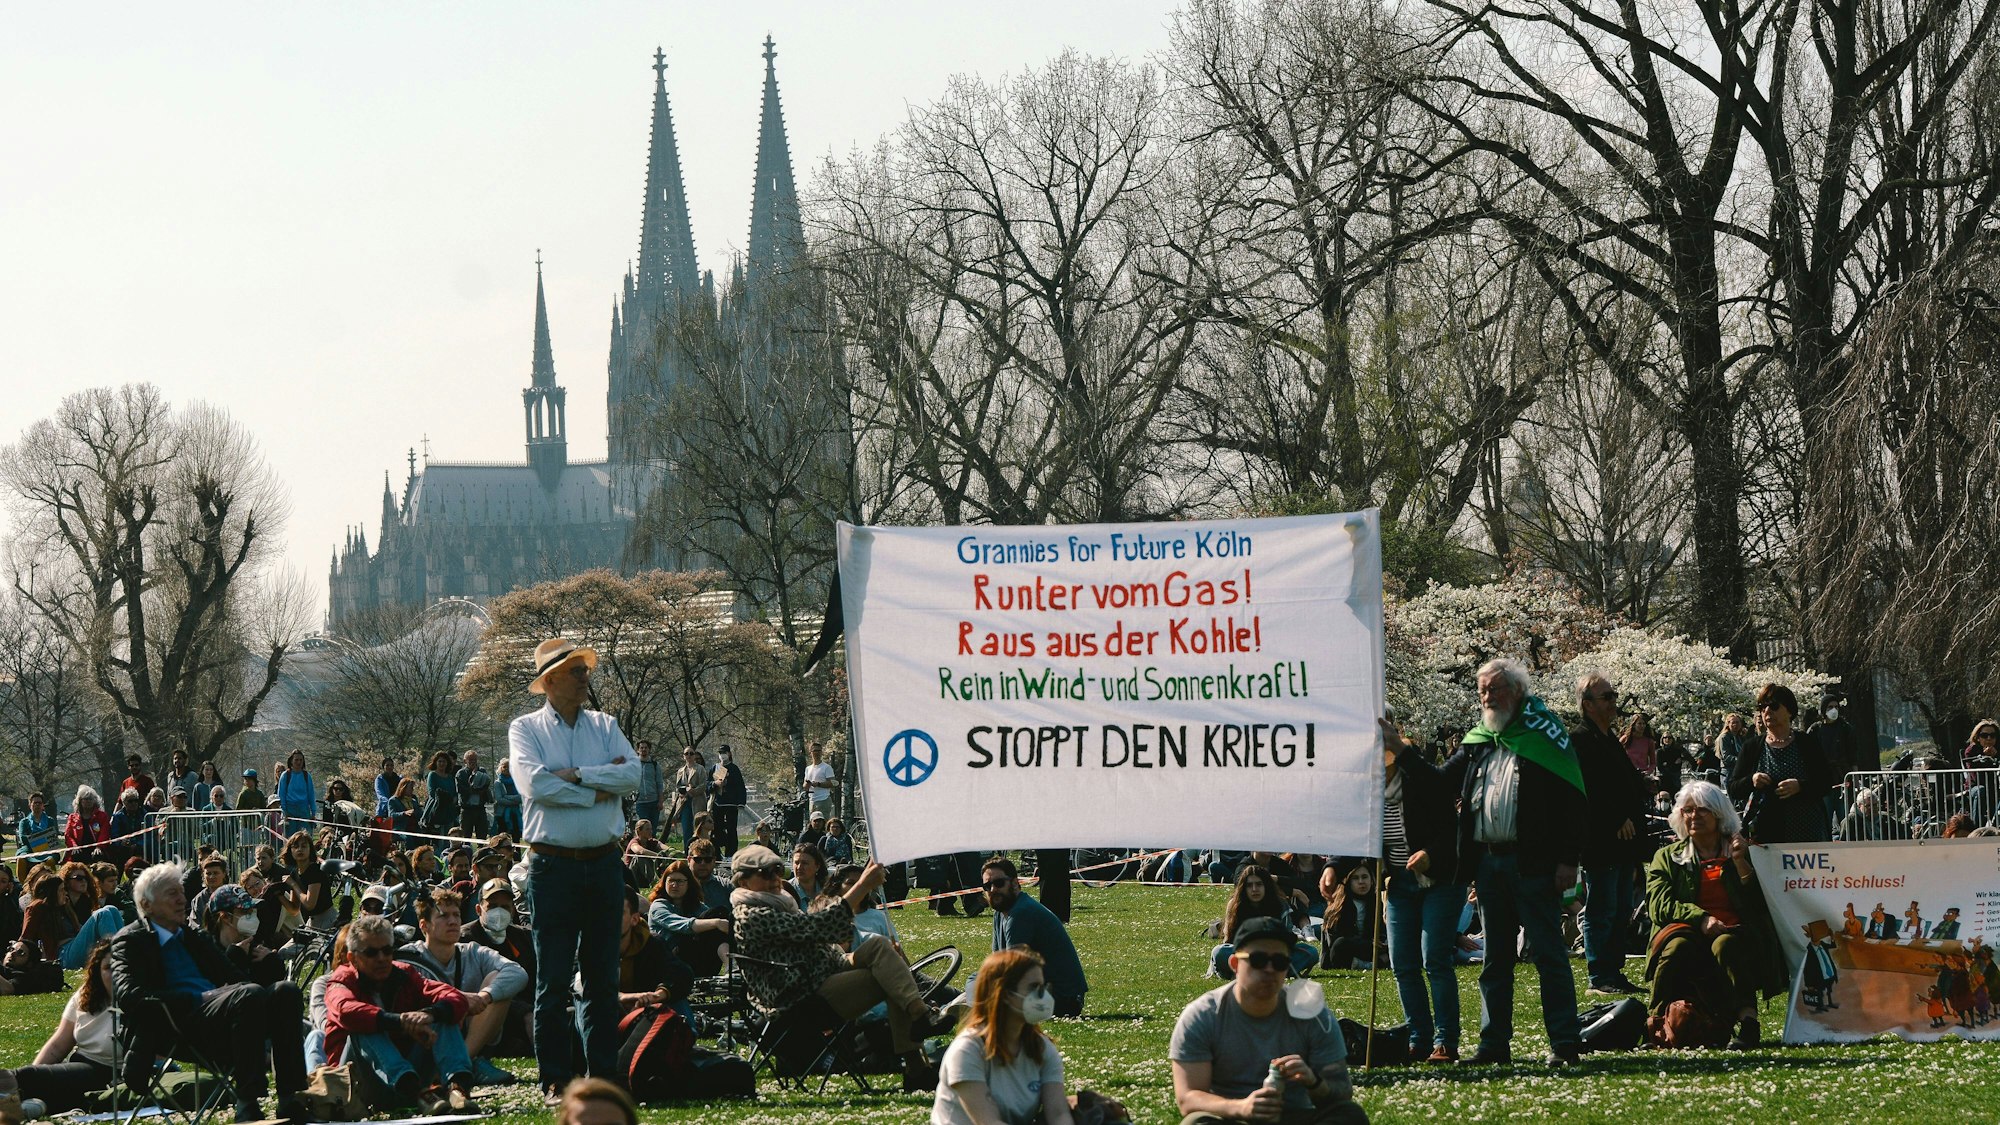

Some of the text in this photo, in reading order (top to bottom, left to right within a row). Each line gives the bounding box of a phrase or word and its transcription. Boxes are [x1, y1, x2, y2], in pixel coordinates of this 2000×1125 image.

[957, 530, 1252, 564] Grannies for Future Köln
[974, 568, 1251, 612] Runter vom Gas!
[958, 616, 1261, 658] Raus aus der Kohle!
[939, 667, 993, 701] Rein
[1000, 671, 1018, 701] in
[1101, 667, 1139, 701] und
[1146, 661, 1308, 701] Sonnenkraft!
[966, 722, 1316, 768] STOPPT DEN KRIEG!
[1782, 852, 1836, 873] RWE,
[1784, 874, 1905, 892] jetzt ist Schluss!
[1804, 994, 1819, 1003] RWE
